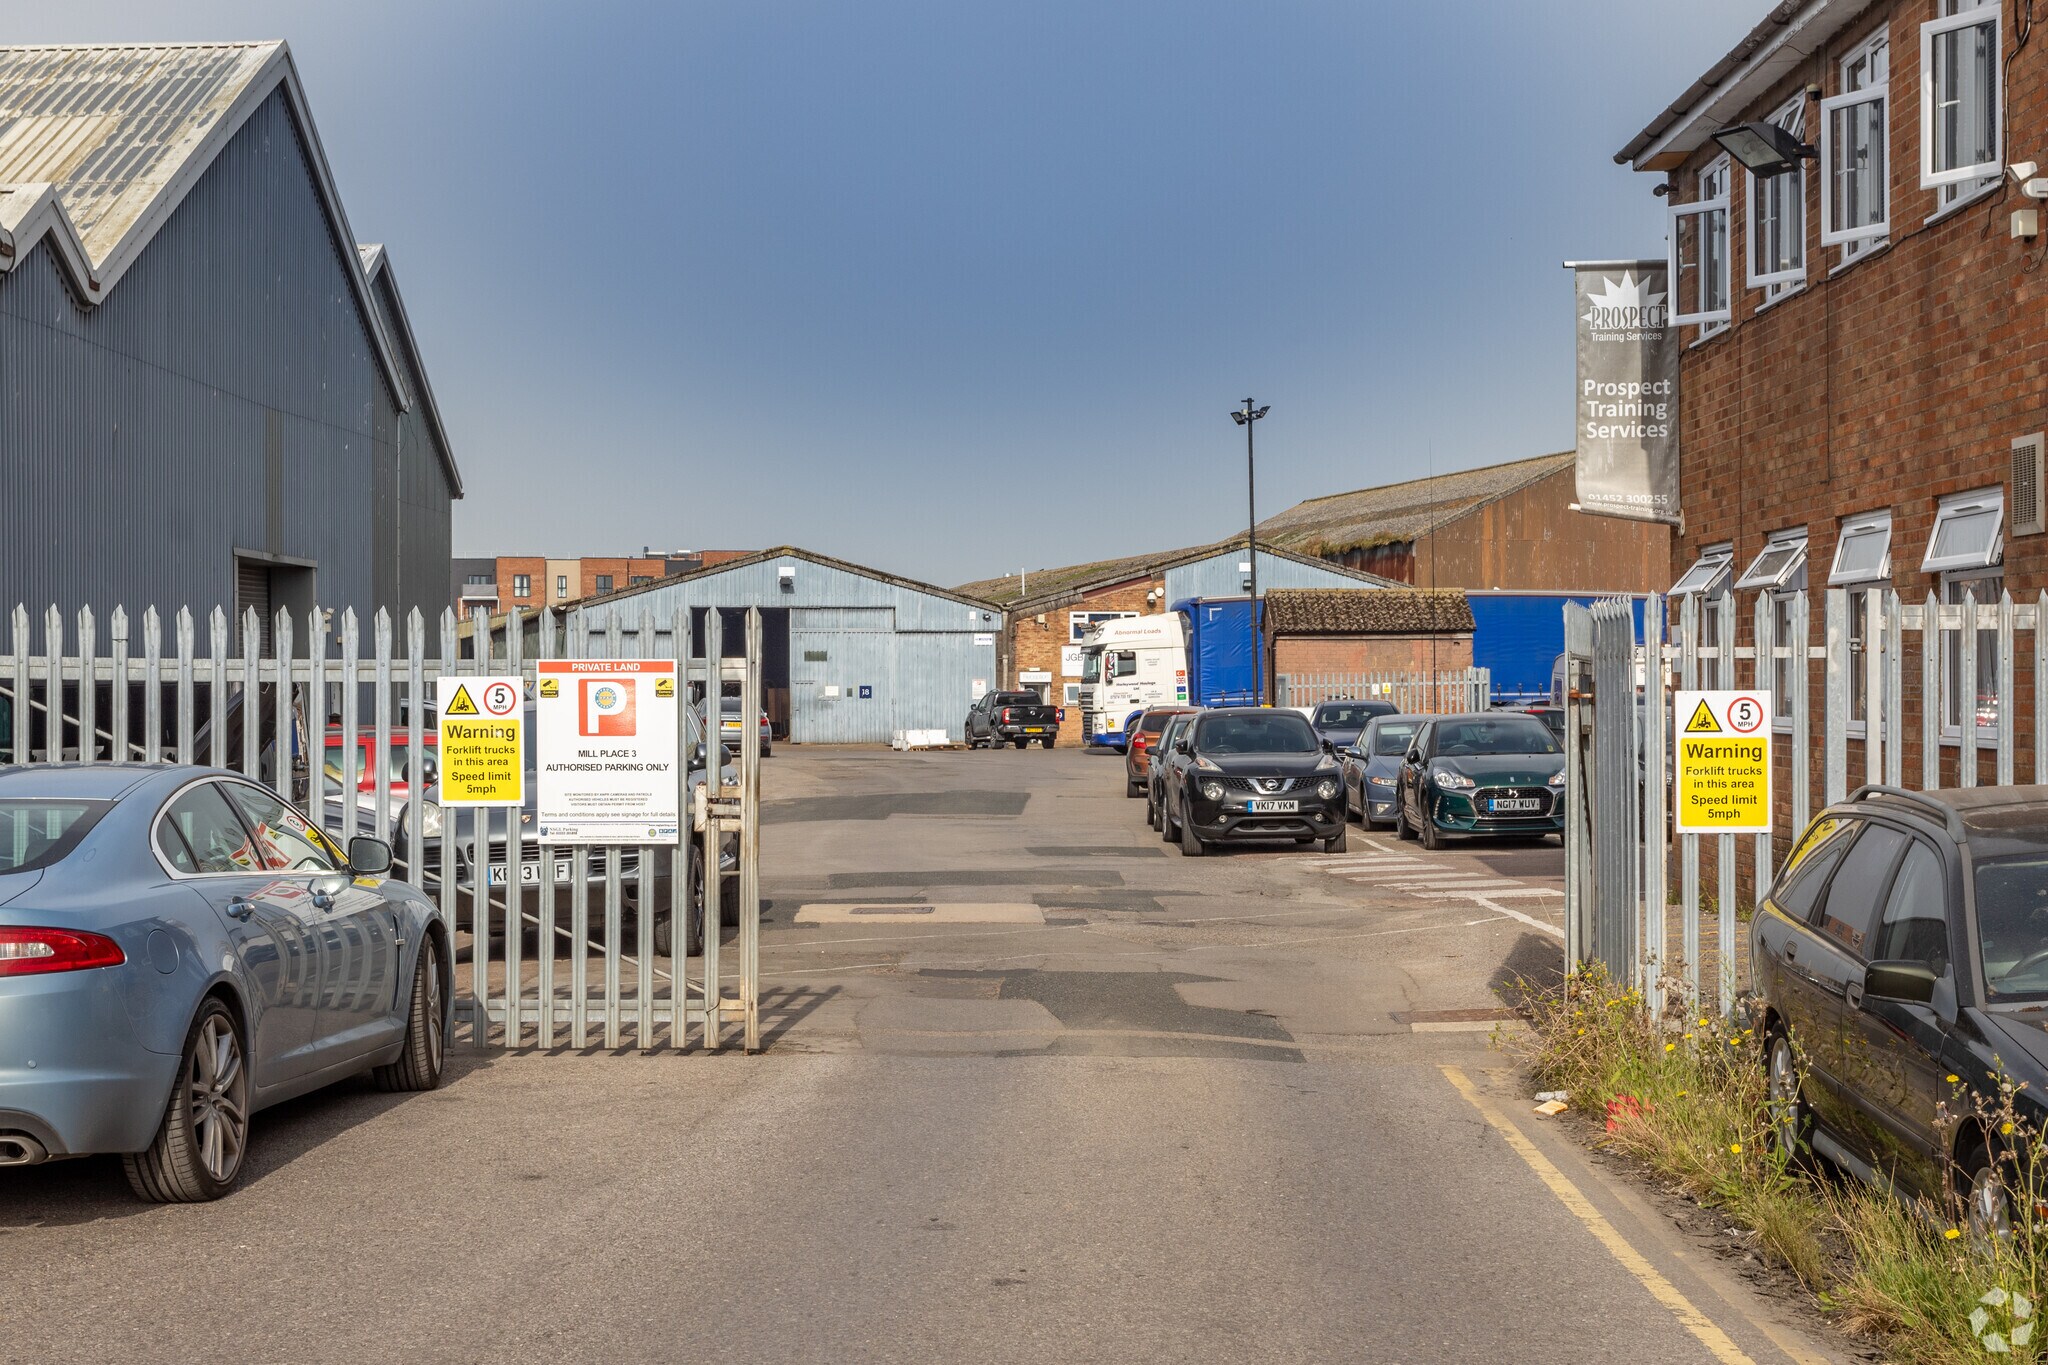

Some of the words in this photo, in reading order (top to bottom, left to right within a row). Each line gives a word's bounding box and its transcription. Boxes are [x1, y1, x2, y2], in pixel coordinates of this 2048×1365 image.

[1590, 305, 1666, 329] PROSPECT
[1591, 332, 1624, 342] Training
[1627, 331, 1662, 341] Services
[1584, 379, 1671, 399] Prospect
[1587, 400, 1667, 420] Training
[1586, 421, 1668, 439] Services
[1588, 494, 1623, 503] 01452
[1626, 494, 1668, 504] 300255
[1586, 501, 1673, 515] www.prospect-training.org.uk
[1066, 653, 1083, 661] JGB
[572, 663, 611, 671] PRIVATE
[614, 663, 640, 671] LAND
[495, 688, 505, 704] 5
[861, 689, 870, 697] 18
[587, 681, 627, 734] P
[1740, 703, 1751, 720] 5
[447, 725, 515, 741] Warning
[446, 745, 481, 754] Forklift
[484, 746, 515, 754] trucks
[1686, 744, 1762, 762] Warning
[453, 758, 463, 766] in
[465, 758, 484, 766] this
[546, 763, 602, 771] AUTHORISED
[605, 763, 643, 771] PARKING
[646, 763, 669, 771] ONLY
[1685, 766, 1725, 775] Forklift
[1728, 767, 1762, 775] trucks
[451, 771, 485, 783] Speed
[488, 771, 511, 781] limit
[1693, 779, 1704, 788] in
[1707, 779, 1727, 788] this
[466, 784, 496, 795] 5mph
[1255, 801, 1275, 810] VK17
[1277, 801, 1295, 810] VKM
[1496, 800, 1517, 808] NG17
[1519, 800, 1536, 808] WUV
[1691, 795, 1728, 807] Speed
[1731, 795, 1757, 805] limit
[1708, 808, 1740, 820] 5mph
